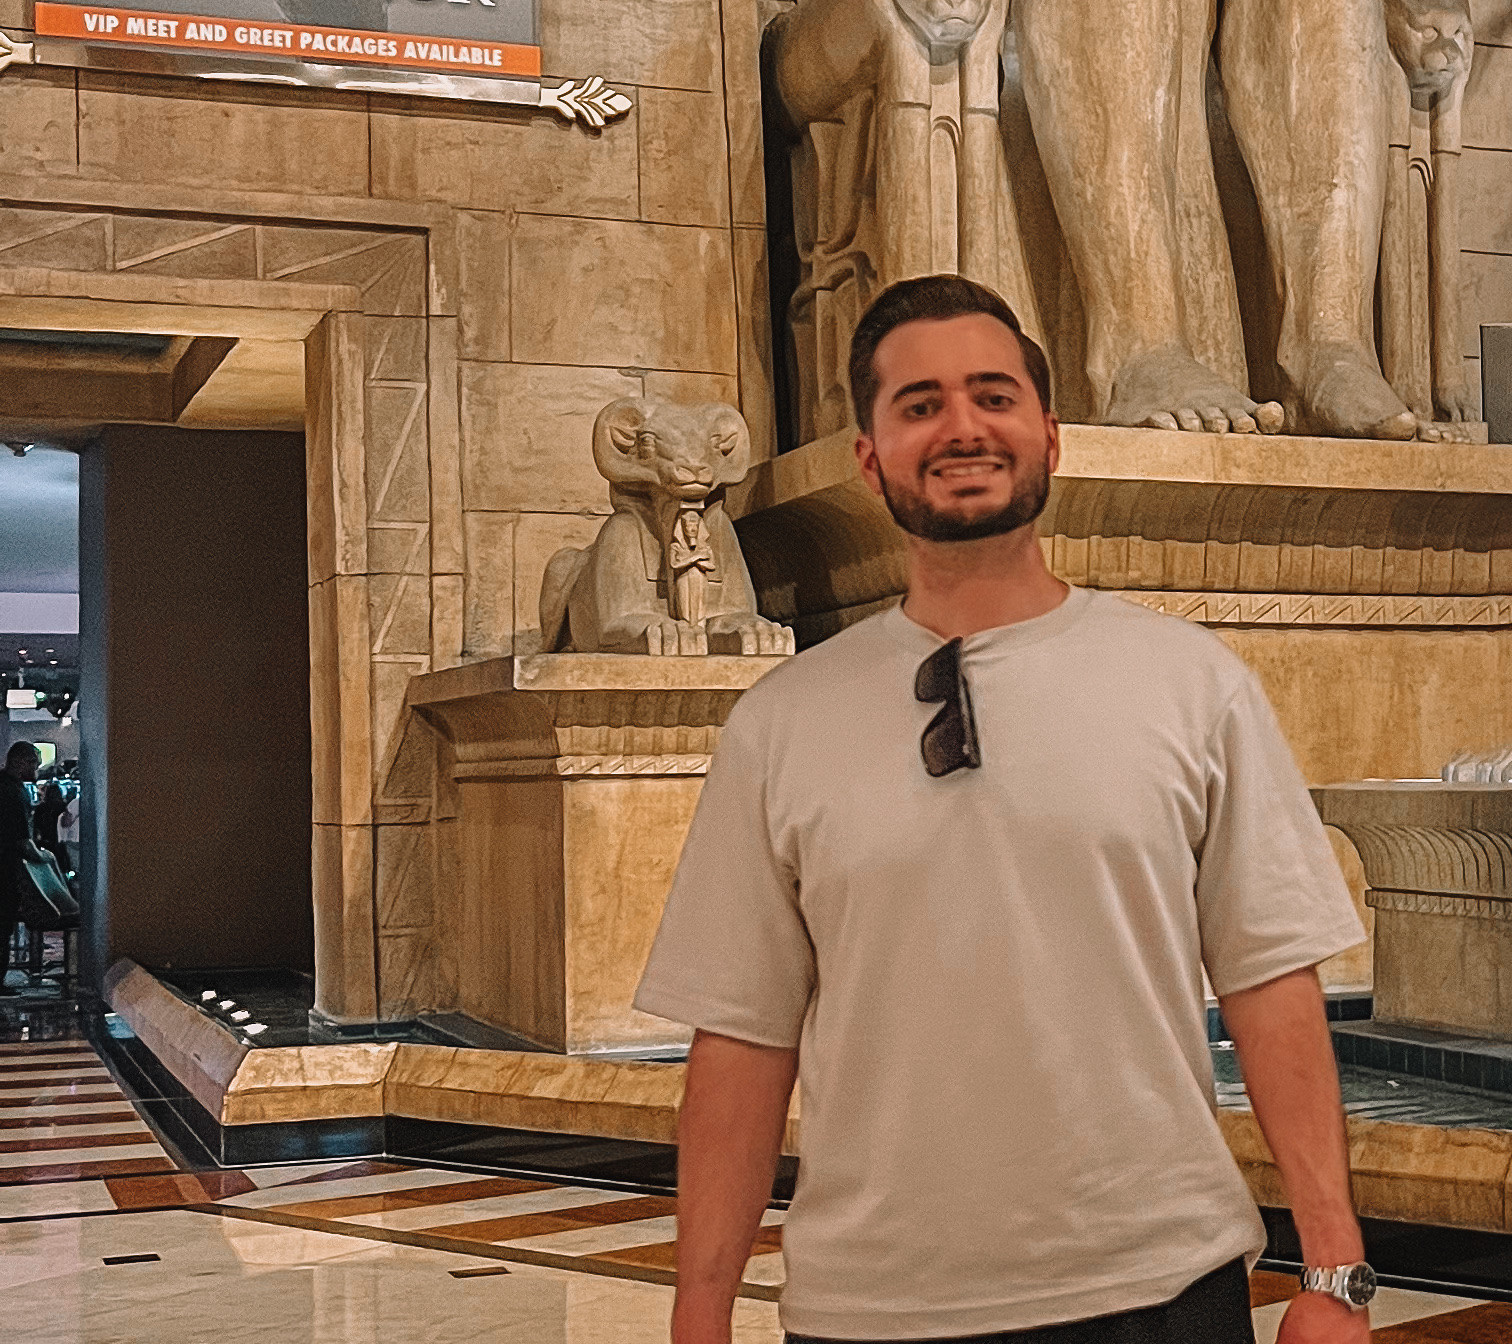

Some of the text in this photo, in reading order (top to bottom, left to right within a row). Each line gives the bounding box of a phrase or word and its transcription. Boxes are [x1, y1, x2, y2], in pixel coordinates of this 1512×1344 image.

[84, 13, 502, 66] VIP MEET AND GREET PACKAGES AVAILABLE
